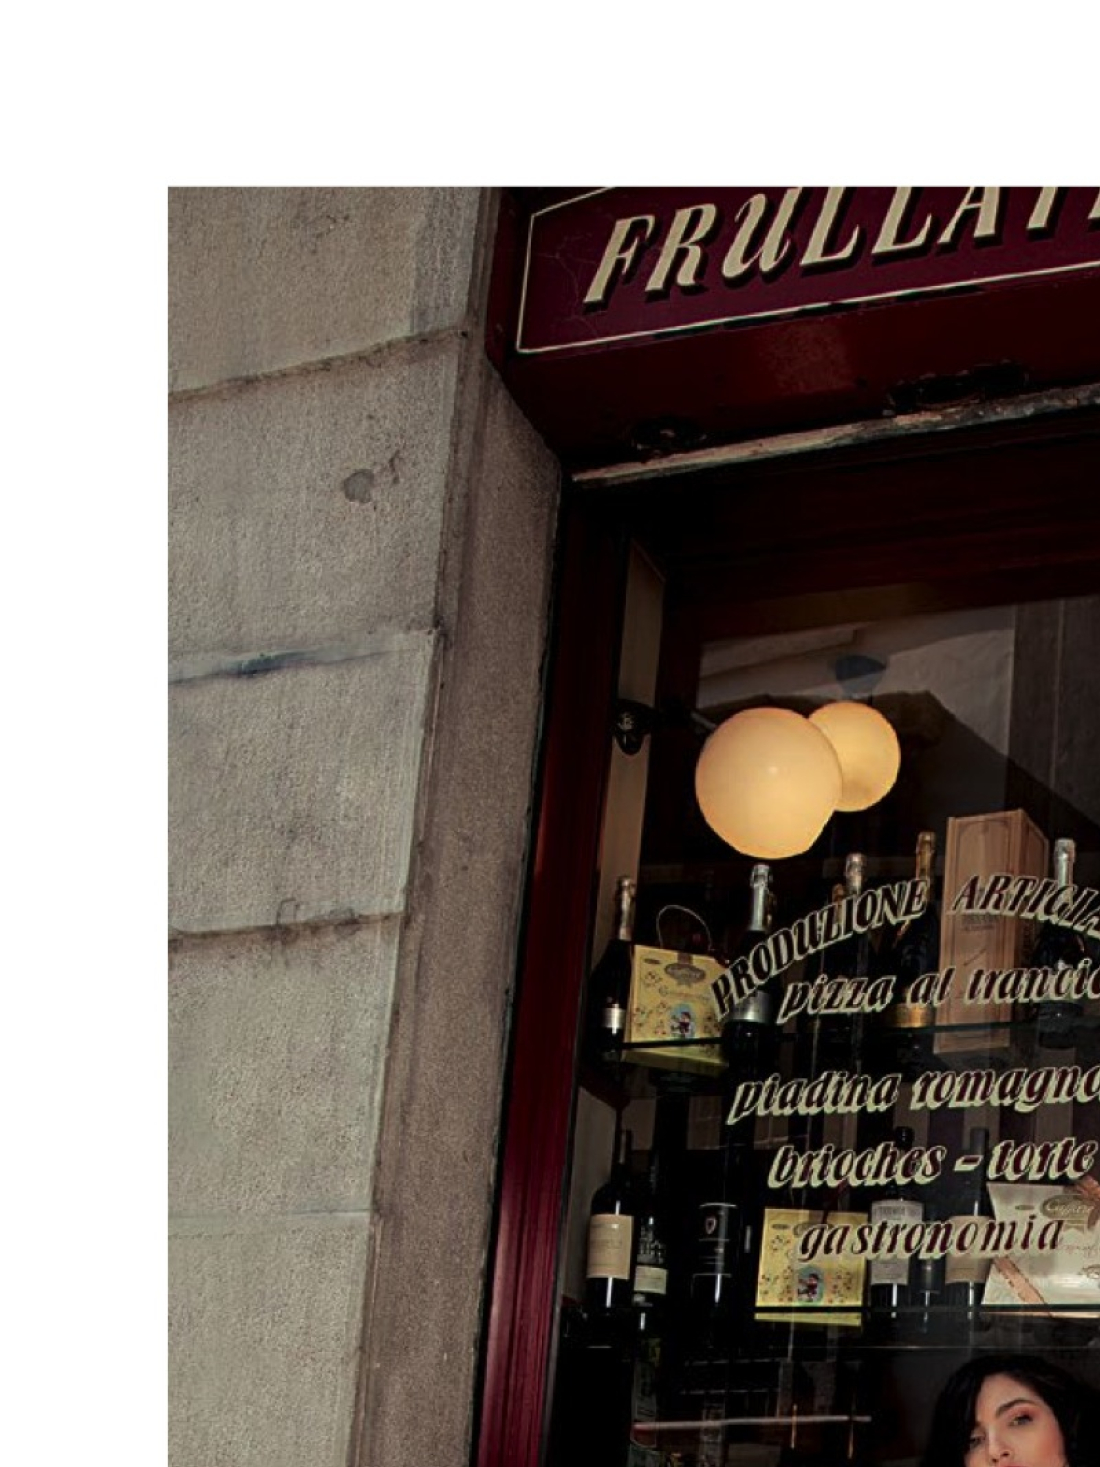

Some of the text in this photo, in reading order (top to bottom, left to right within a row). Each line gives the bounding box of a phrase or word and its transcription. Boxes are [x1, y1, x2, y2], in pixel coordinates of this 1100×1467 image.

[710, 878, 930, 1021] PRODUZIONE
[777, 973, 895, 1026] pizza
[905, 966, 955, 1008] al
[727, 1070, 902, 1126] piadina
[767, 1138, 947, 1190] brioches
[987, 1136, 1099, 1181] torte
[798, 1214, 1066, 1262] gastronomia
